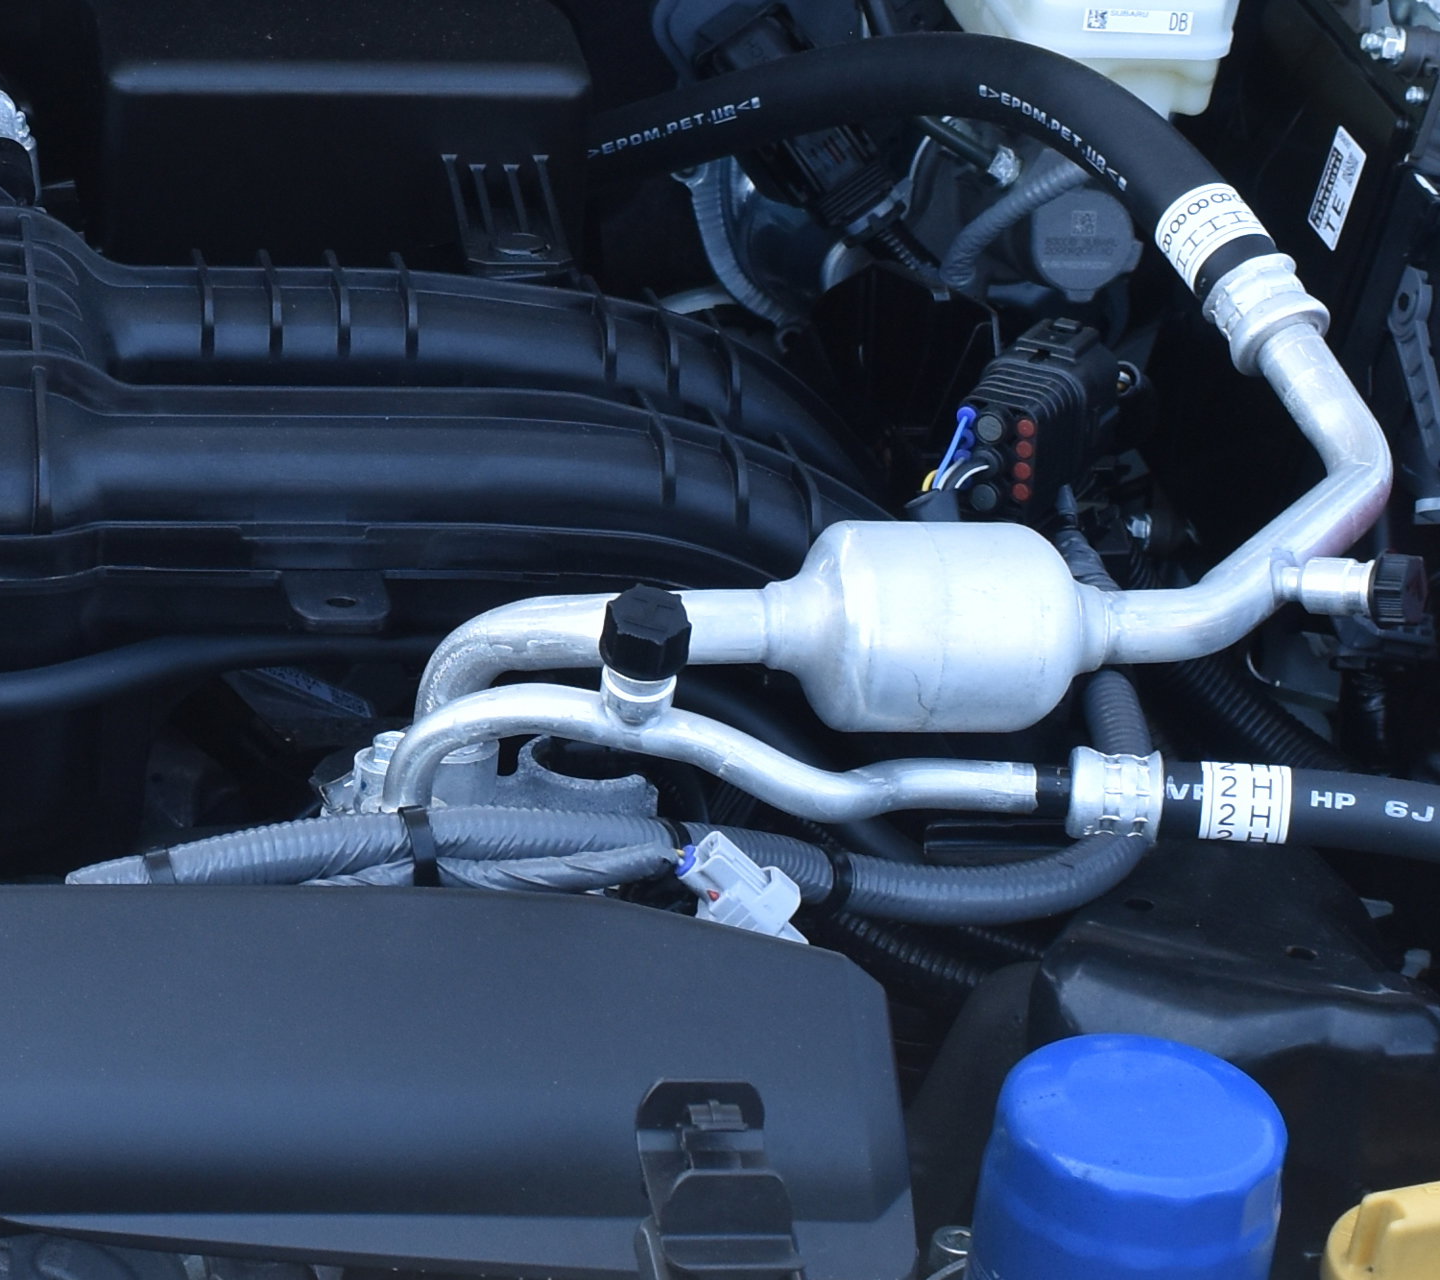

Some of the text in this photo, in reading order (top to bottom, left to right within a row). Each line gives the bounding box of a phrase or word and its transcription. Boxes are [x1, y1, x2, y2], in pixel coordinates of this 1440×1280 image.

[1169, 12, 1188, 32] DB
[1221, 776, 1237, 798] 2
[1252, 777, 1272, 800] H
[1218, 803, 1271, 828] 2 H
[1310, 790, 1356, 810] HP
[1384, 800, 1435, 822] 6J
